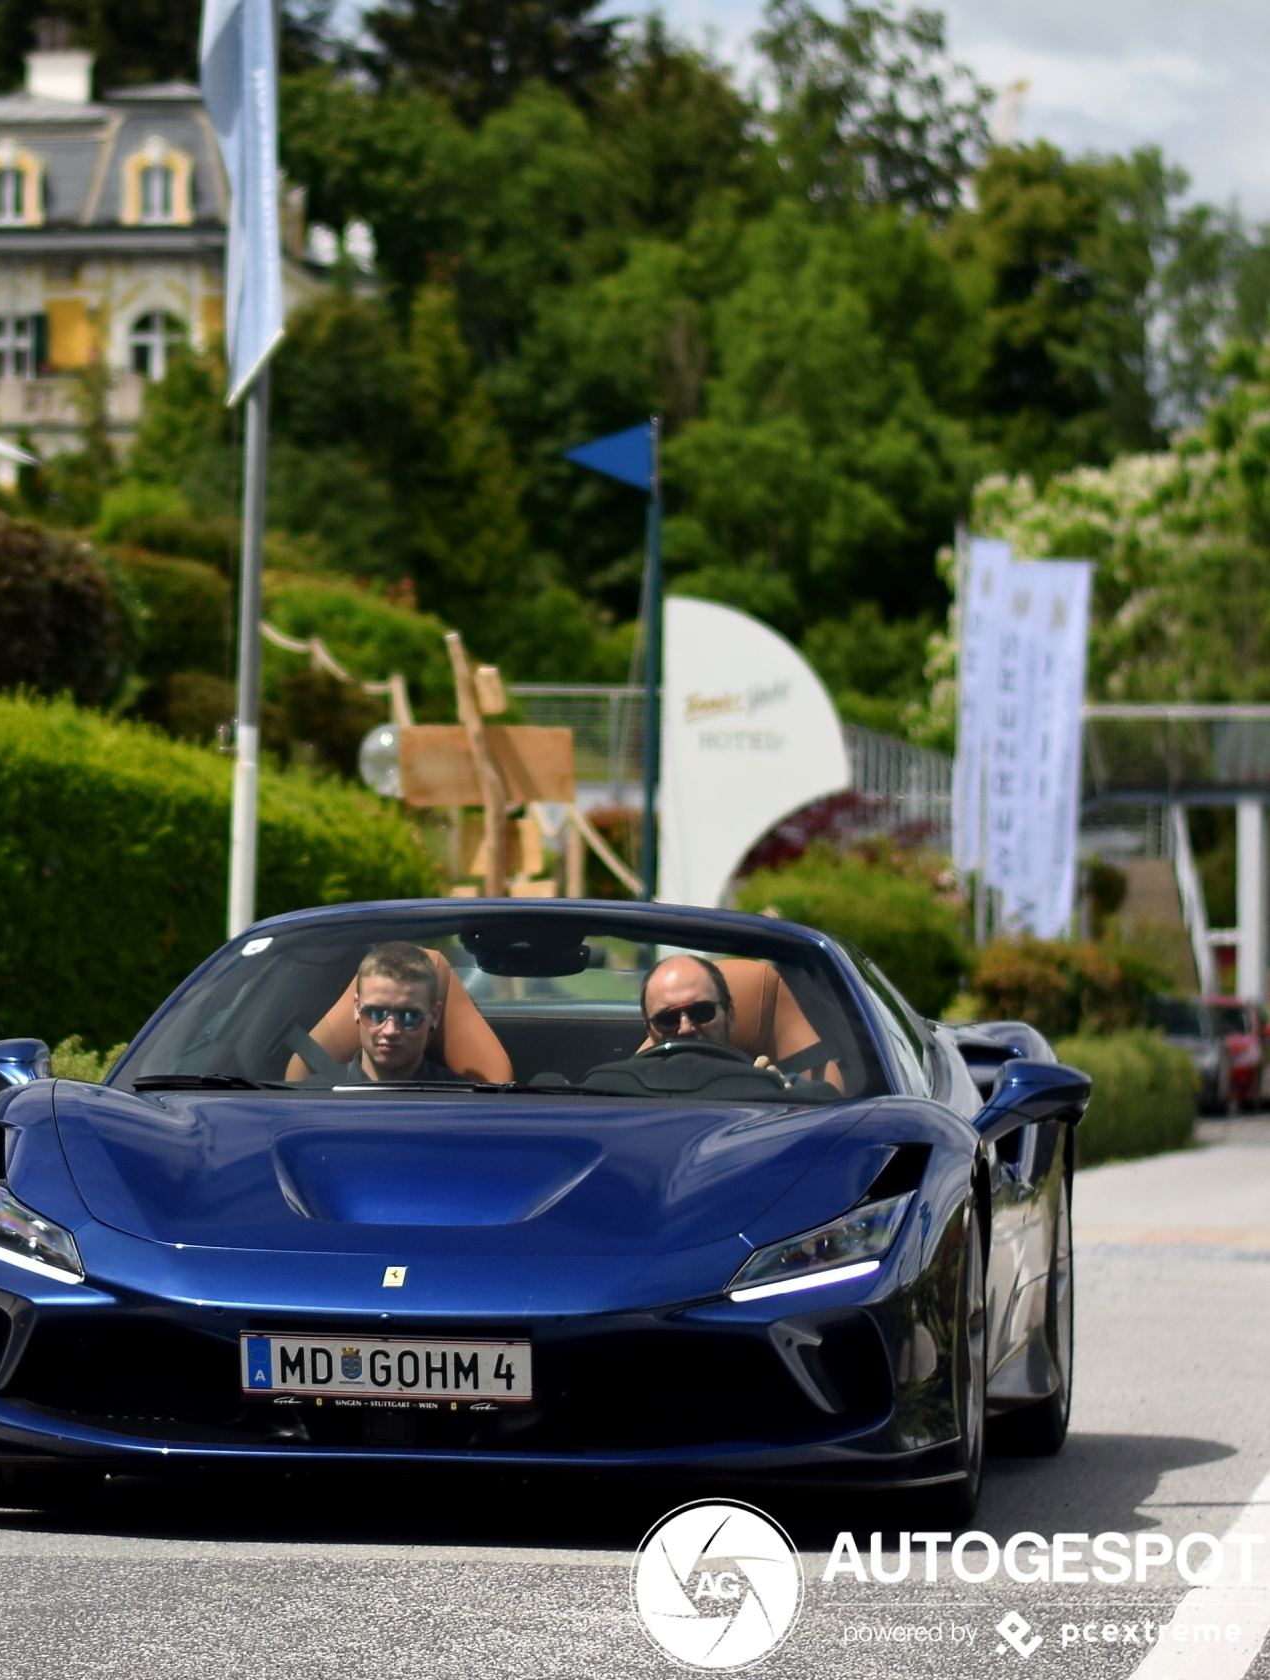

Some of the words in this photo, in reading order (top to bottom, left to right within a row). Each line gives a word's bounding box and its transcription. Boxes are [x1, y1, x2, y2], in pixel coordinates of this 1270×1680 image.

[279, 1345, 333, 1385] MD
[369, 1348, 479, 1390] GOHM
[493, 1352, 516, 1391] 4
[254, 1369, 267, 1382] A
[334, 1399, 362, 1407] SINGEN
[370, 1400, 410, 1409] STUTTGART
